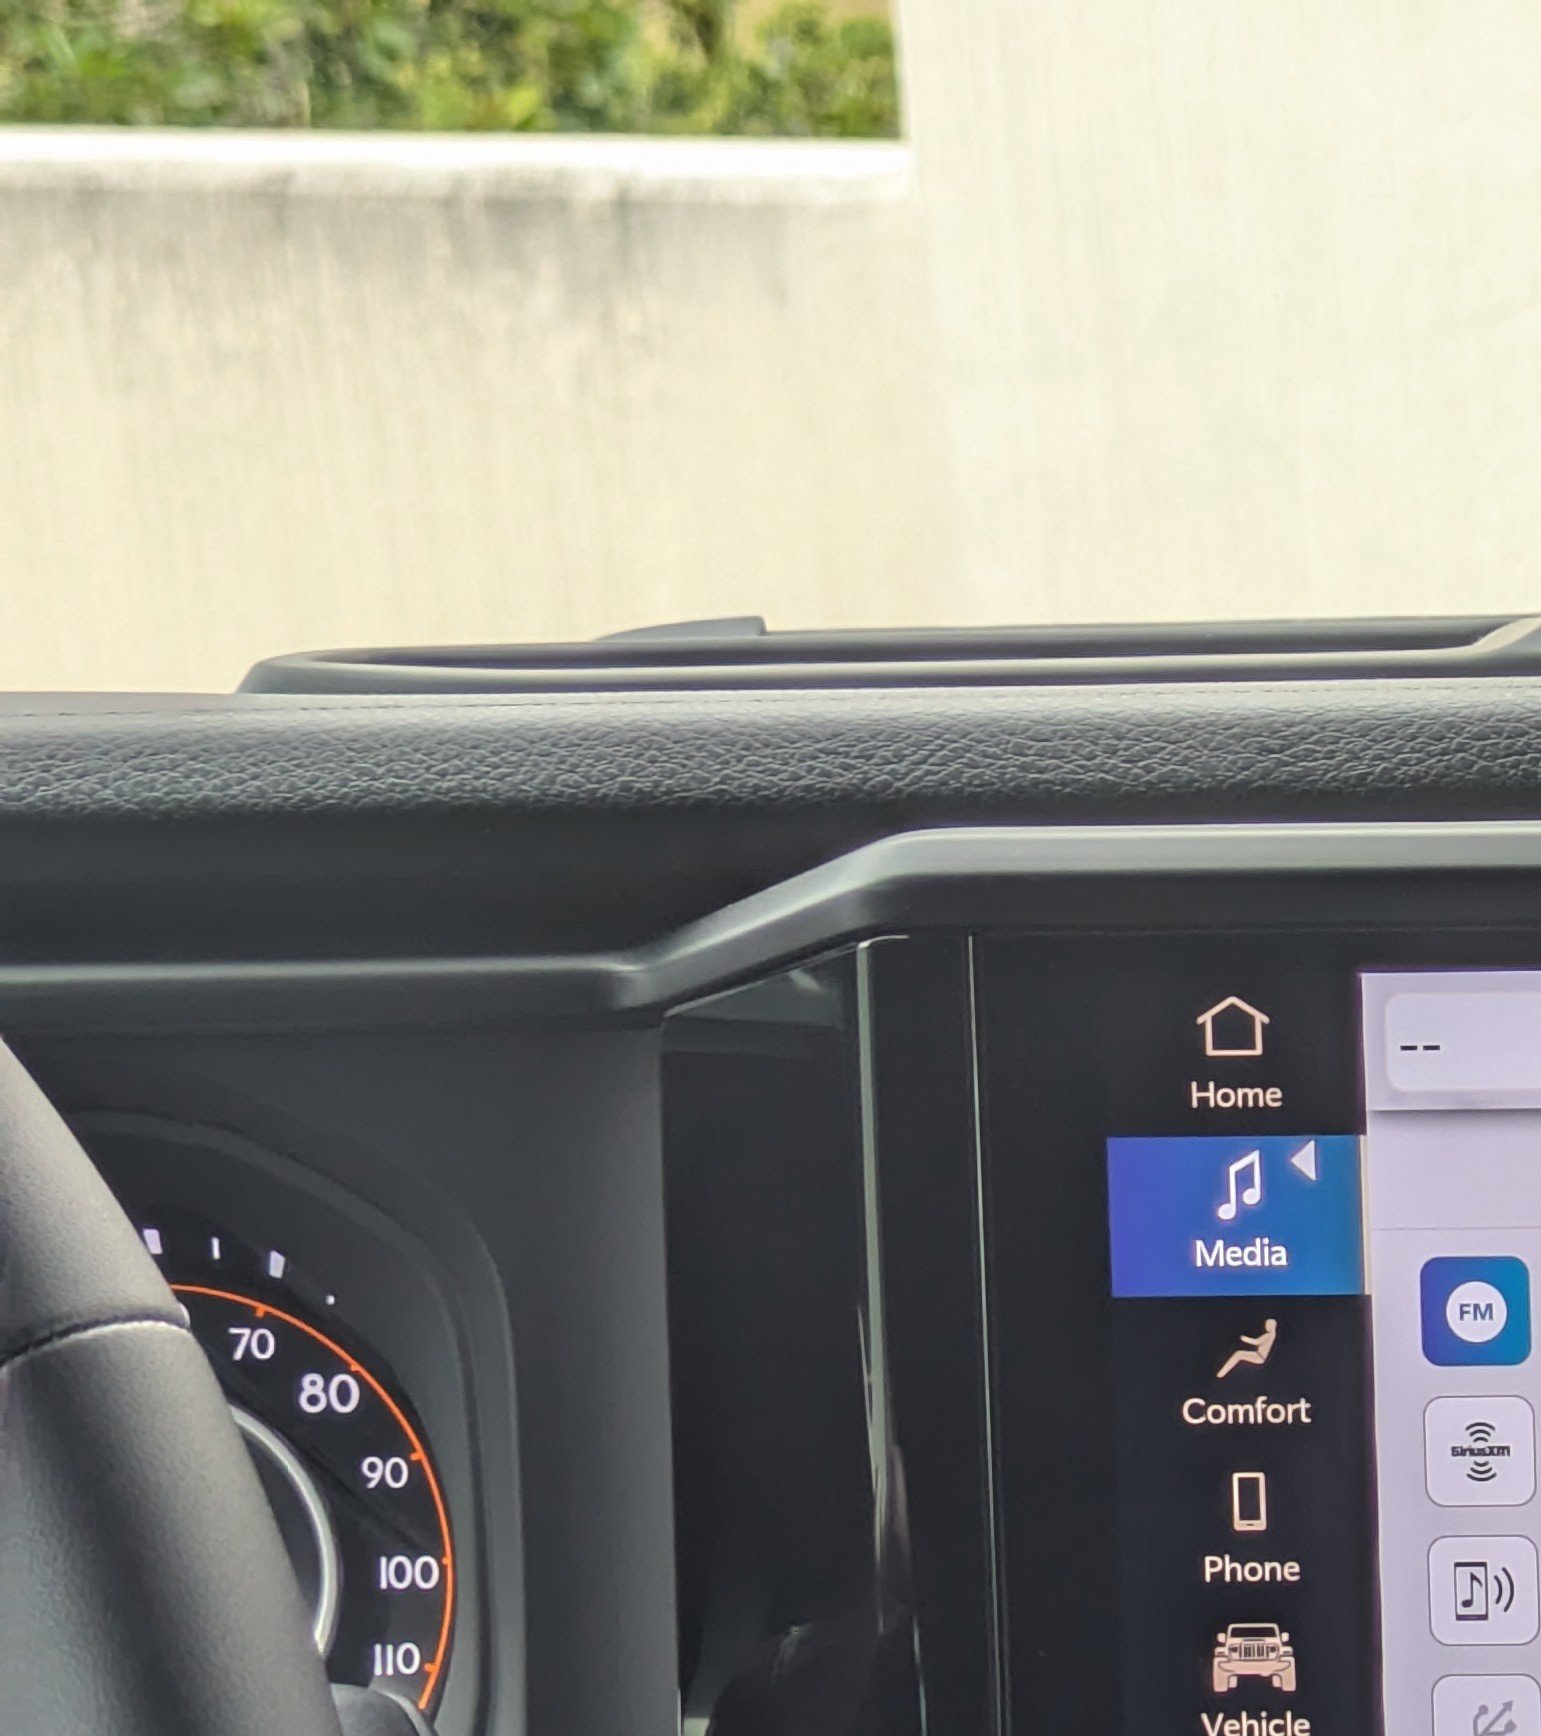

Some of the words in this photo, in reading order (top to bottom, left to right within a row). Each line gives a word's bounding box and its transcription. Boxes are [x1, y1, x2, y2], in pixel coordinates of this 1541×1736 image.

[1191, 1081, 1282, 1108] Home
[1194, 1238, 1287, 1268] Media
[1459, 1303, 1494, 1321] FM
[229, 1327, 275, 1361] 70
[300, 1373, 360, 1413] 80
[1182, 1396, 1311, 1425] Comfort
[361, 1457, 409, 1489] 90
[379, 1555, 440, 1590] 100
[1204, 1554, 1301, 1583] Phone
[373, 1642, 420, 1675] 110
